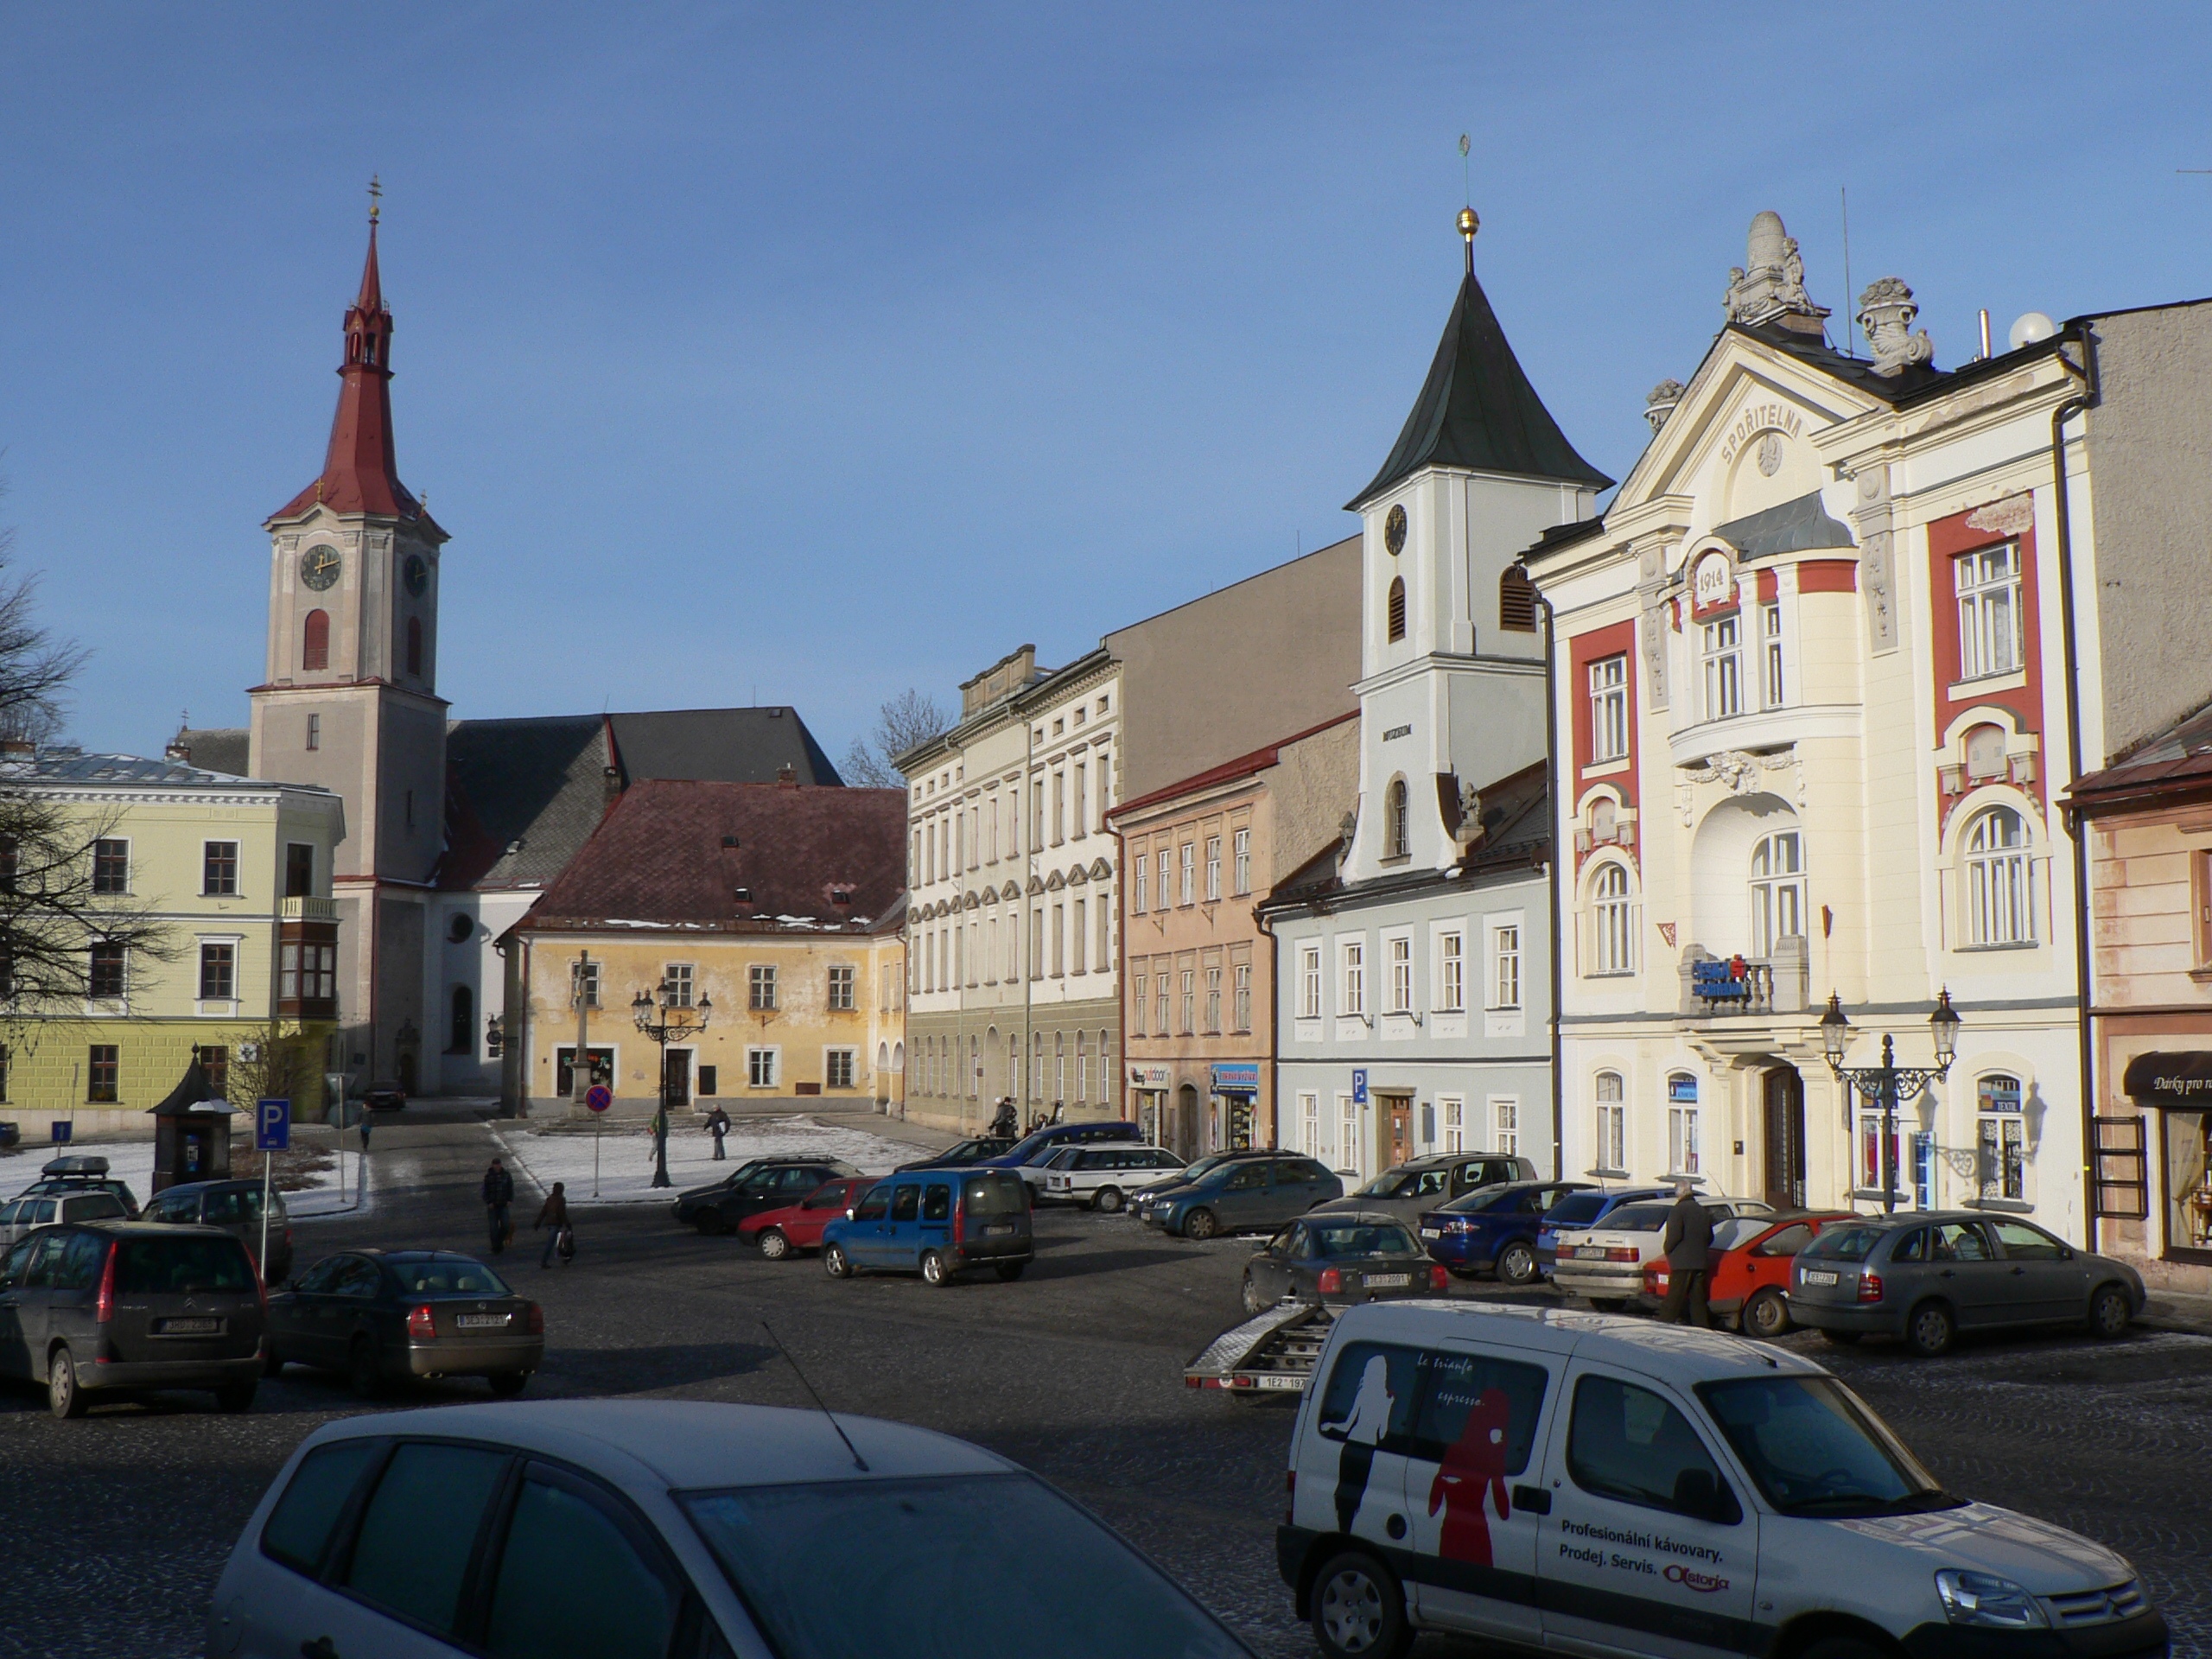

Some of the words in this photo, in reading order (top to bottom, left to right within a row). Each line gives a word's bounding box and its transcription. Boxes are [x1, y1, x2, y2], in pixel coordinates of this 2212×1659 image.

[1721, 404, 1802, 466] SPOŘITELNA
[1700, 567, 1724, 594] 1914
[1382, 723, 1412, 742] MUZEUM
[1354, 1072, 1364, 1094] P
[2185, 1078, 2203, 1096] pro
[1997, 1100, 2018, 1112] TEXTIL
[263, 1105, 283, 1135] P
[1561, 1519, 1650, 1548] Profesionální
[1655, 1535, 1723, 1564] kávovary.
[1560, 1543, 1607, 1567] Prodej.
[1611, 1554, 1657, 1575] Servis.
